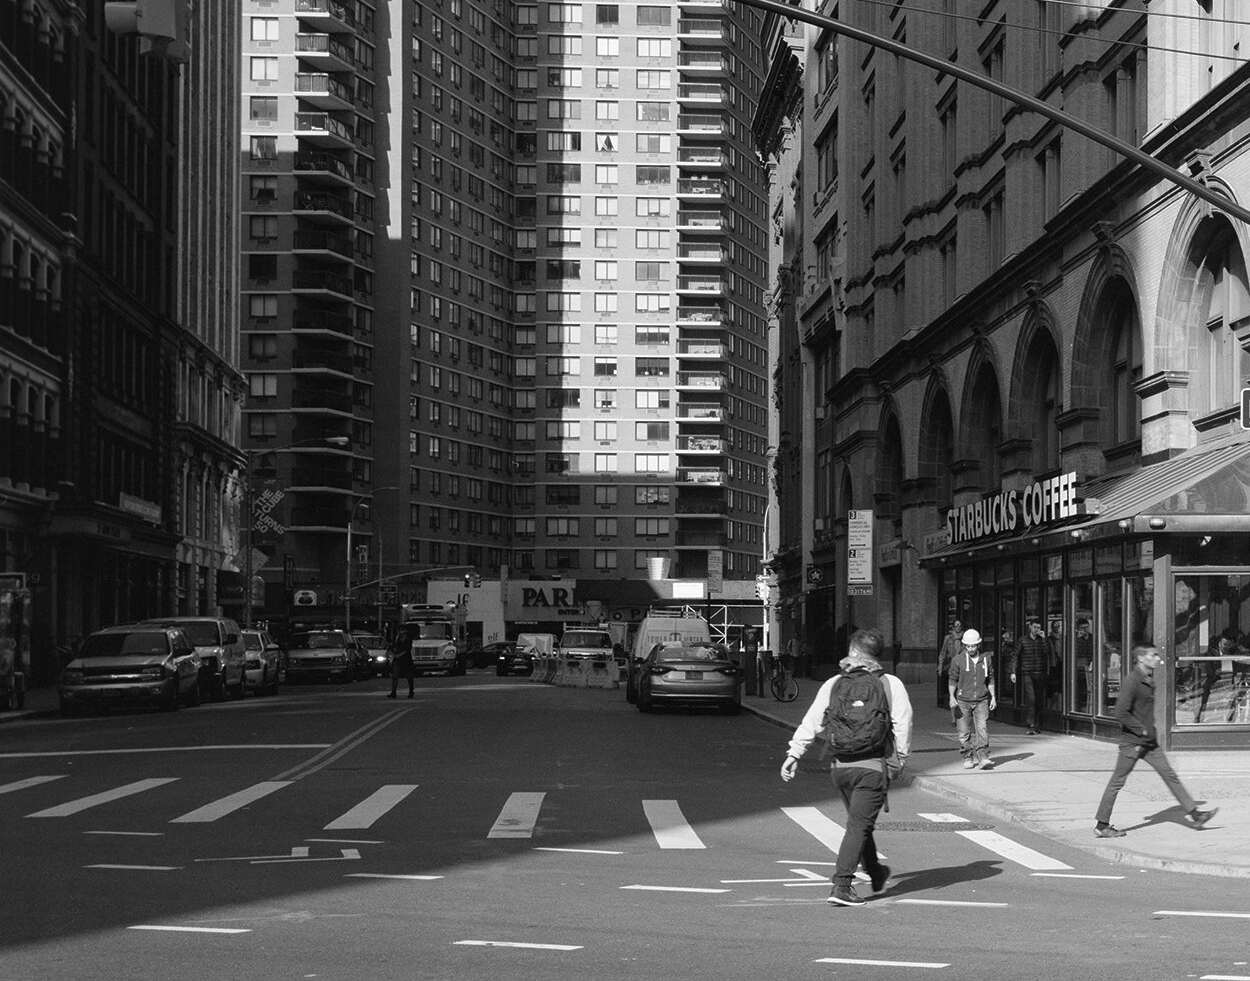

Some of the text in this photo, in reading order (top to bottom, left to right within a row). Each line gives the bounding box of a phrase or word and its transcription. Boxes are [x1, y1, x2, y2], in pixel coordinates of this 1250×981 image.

[254, 488, 274, 507] THE
[261, 489, 285, 514] CUBE
[946, 470, 1078, 545] STARBUCKS COFFEE
[254, 508, 286, 535] TURNS
[254, 520, 269, 534] 50
